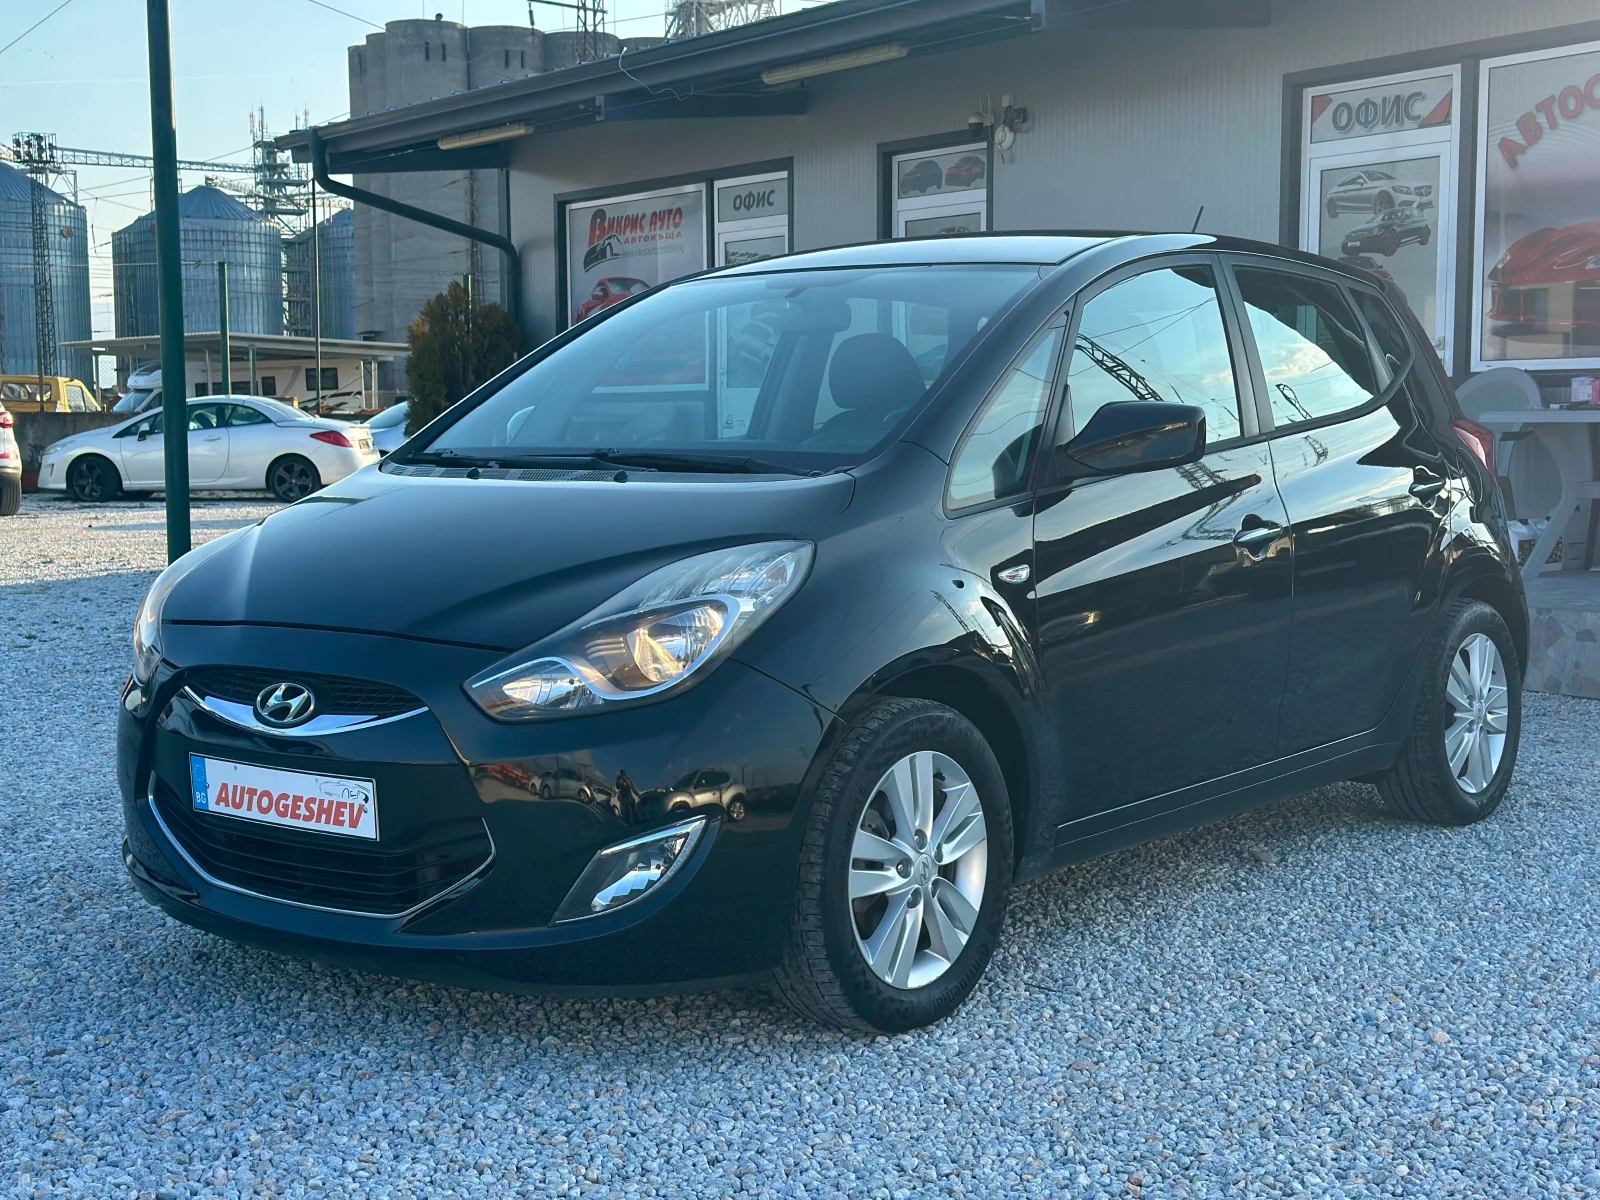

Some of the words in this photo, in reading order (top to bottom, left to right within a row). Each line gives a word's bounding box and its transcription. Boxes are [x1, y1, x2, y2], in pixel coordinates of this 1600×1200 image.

[1332, 91, 1423, 132] ОФИС
[733, 189, 775, 211] ОФИС
[649, 206, 683, 233] АУТО
[623, 231, 682, 244] АВТОКЪЩА
[195, 790, 206, 804] BG
[214, 782, 365, 829] AUTOGESHEV
